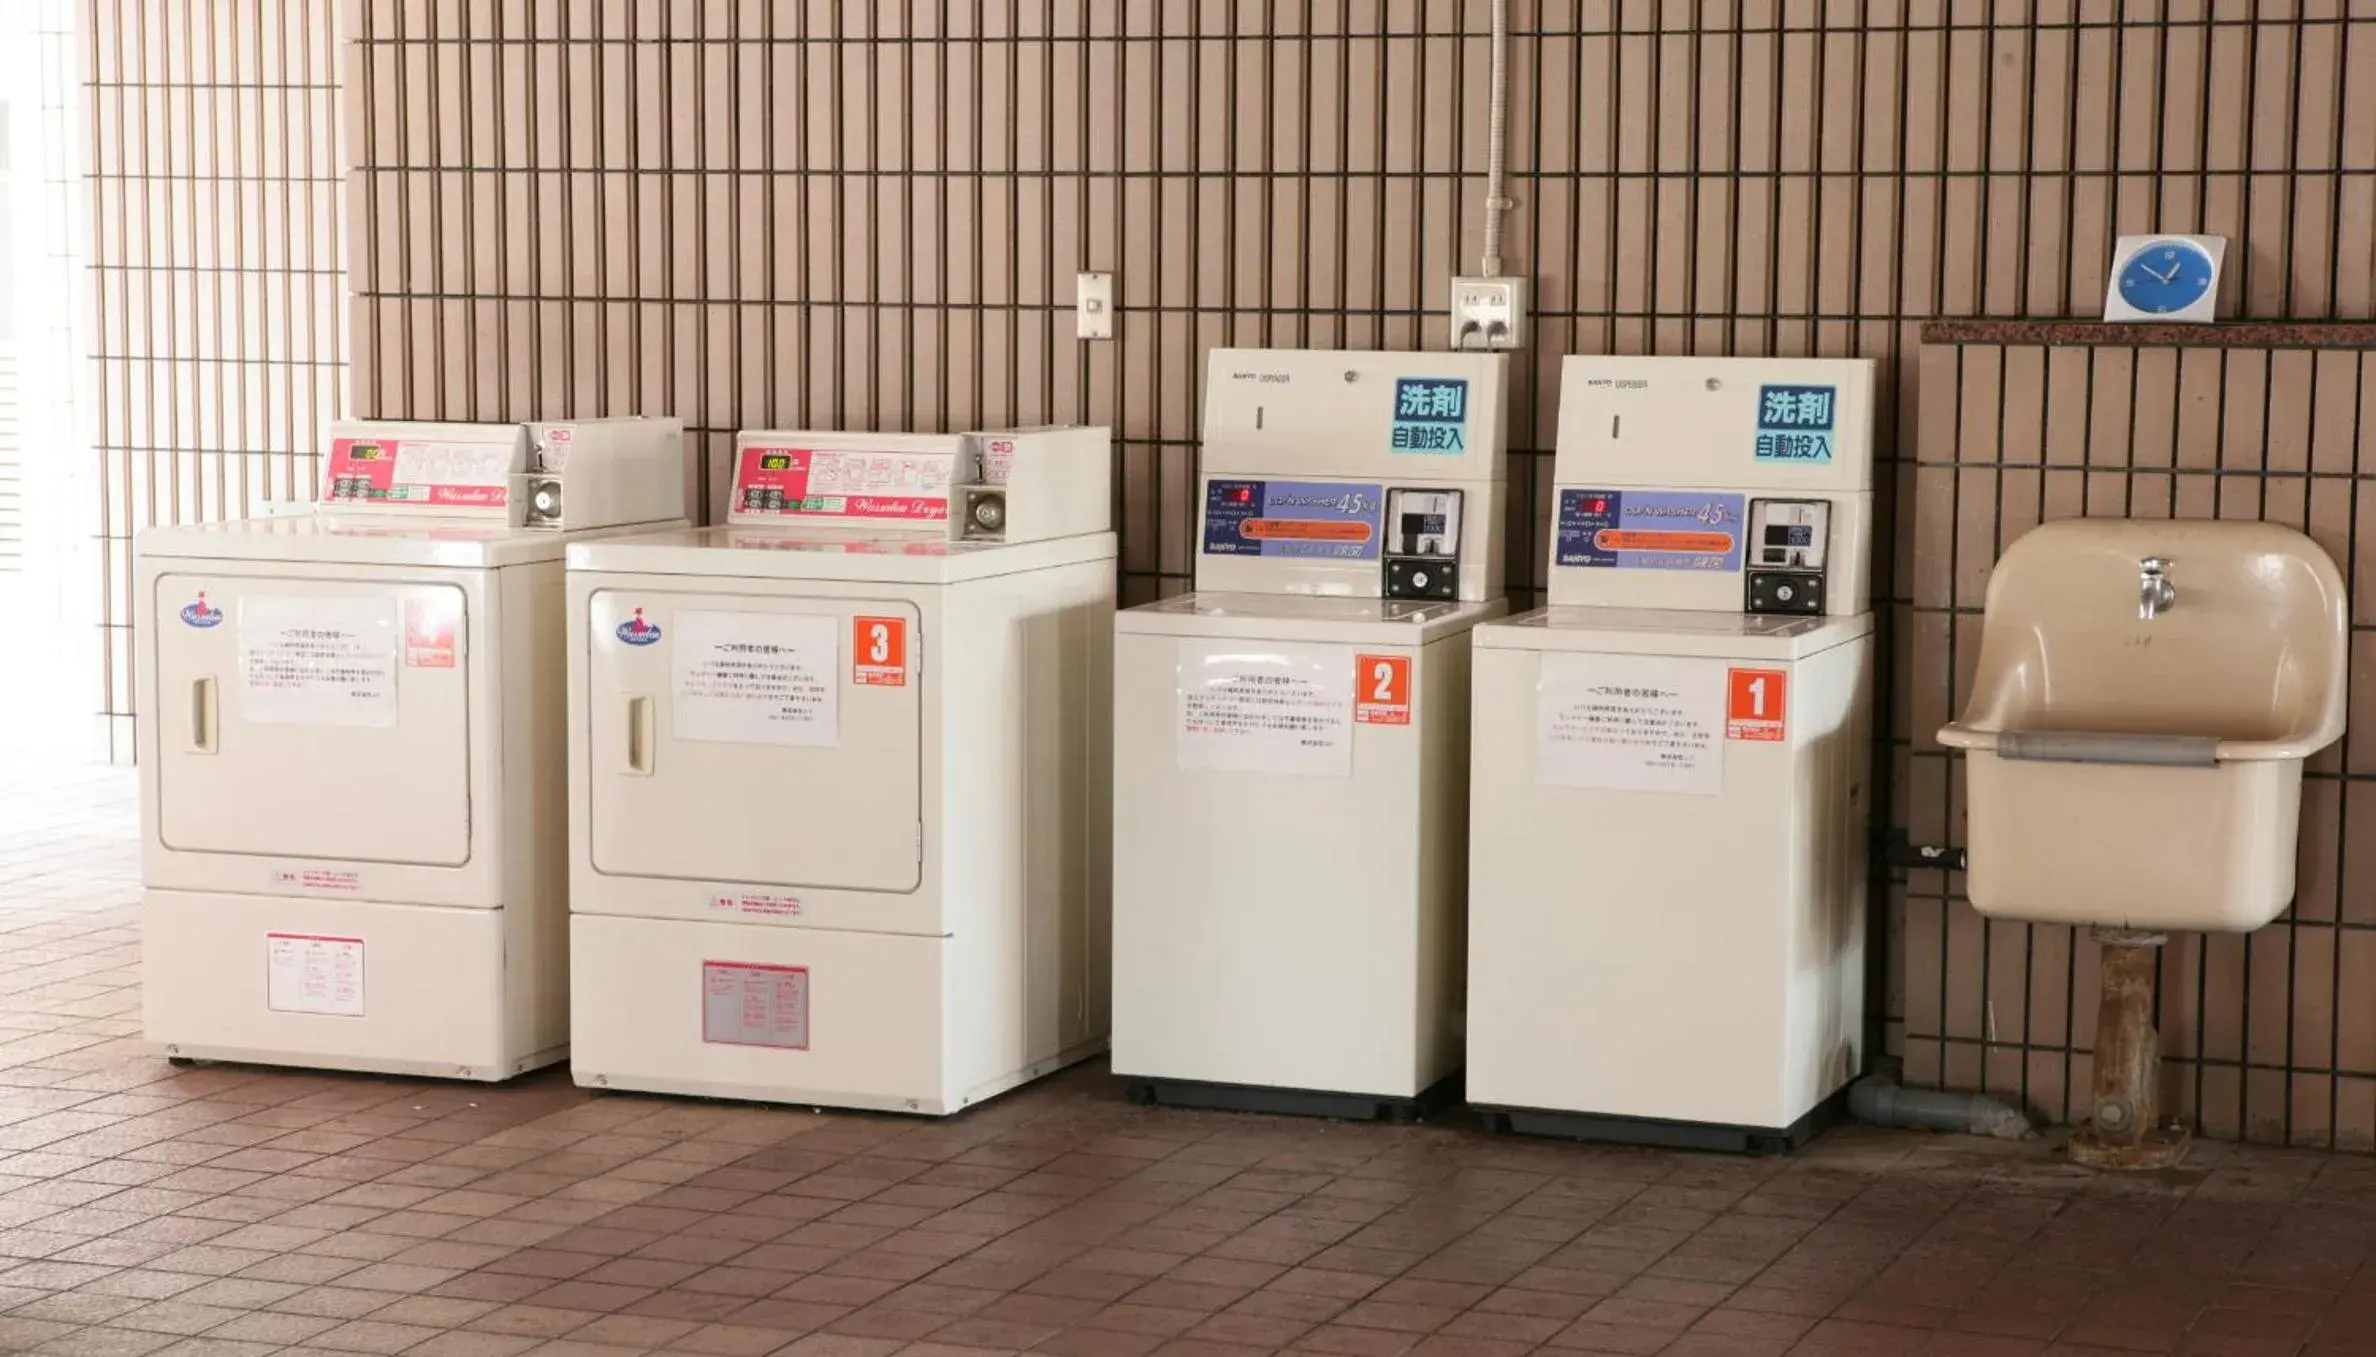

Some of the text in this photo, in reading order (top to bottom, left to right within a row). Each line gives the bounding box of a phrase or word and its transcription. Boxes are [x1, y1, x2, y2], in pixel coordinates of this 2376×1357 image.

[1400, 384, 1463, 417] 洗剤
[1764, 391, 1830, 425] 洗剤
[1392, 426, 1463, 449] 自動投入
[1756, 434, 1831, 458] 自動投入
[1595, 501, 1605, 512] 0
[1562, 554, 1592, 563] SANYO
[871, 624, 889, 662] 3
[1374, 662, 1393, 699] 2
[1748, 677, 1765, 716] 1
